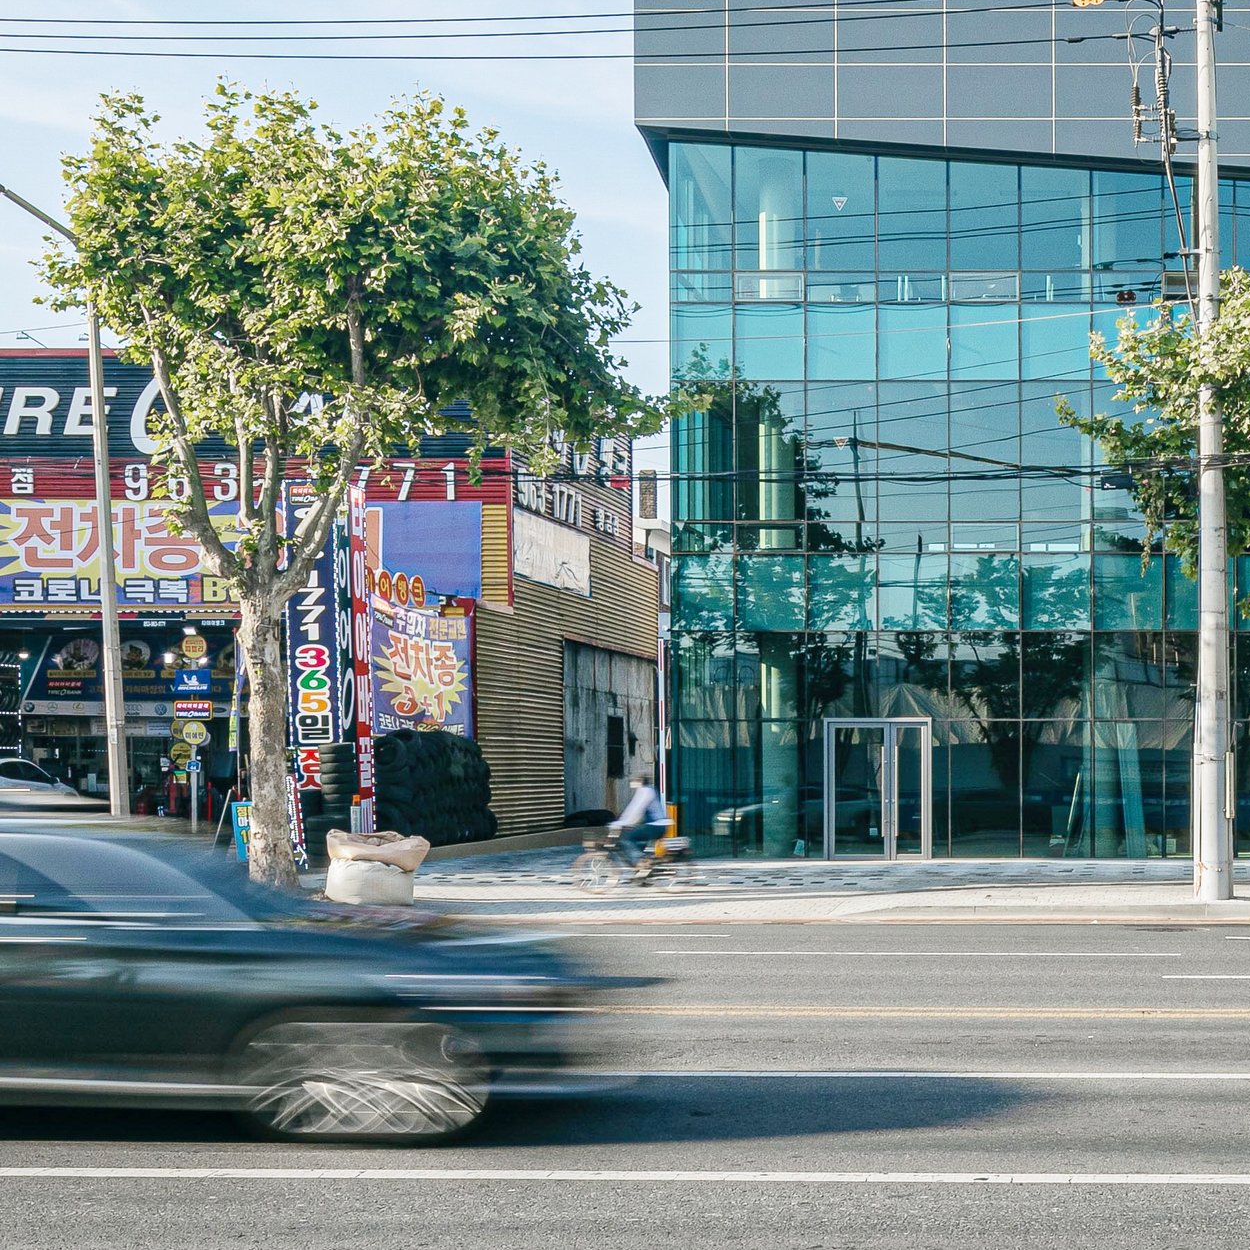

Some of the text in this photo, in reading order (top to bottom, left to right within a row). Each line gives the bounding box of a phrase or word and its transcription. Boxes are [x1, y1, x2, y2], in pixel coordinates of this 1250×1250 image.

[0, 387, 118, 436] RE
[11, 468, 34, 494] 점
[124, 579, 189, 602] 극복
[388, 631, 457, 687] 전차종
[296, 644, 333, 743] 365일
